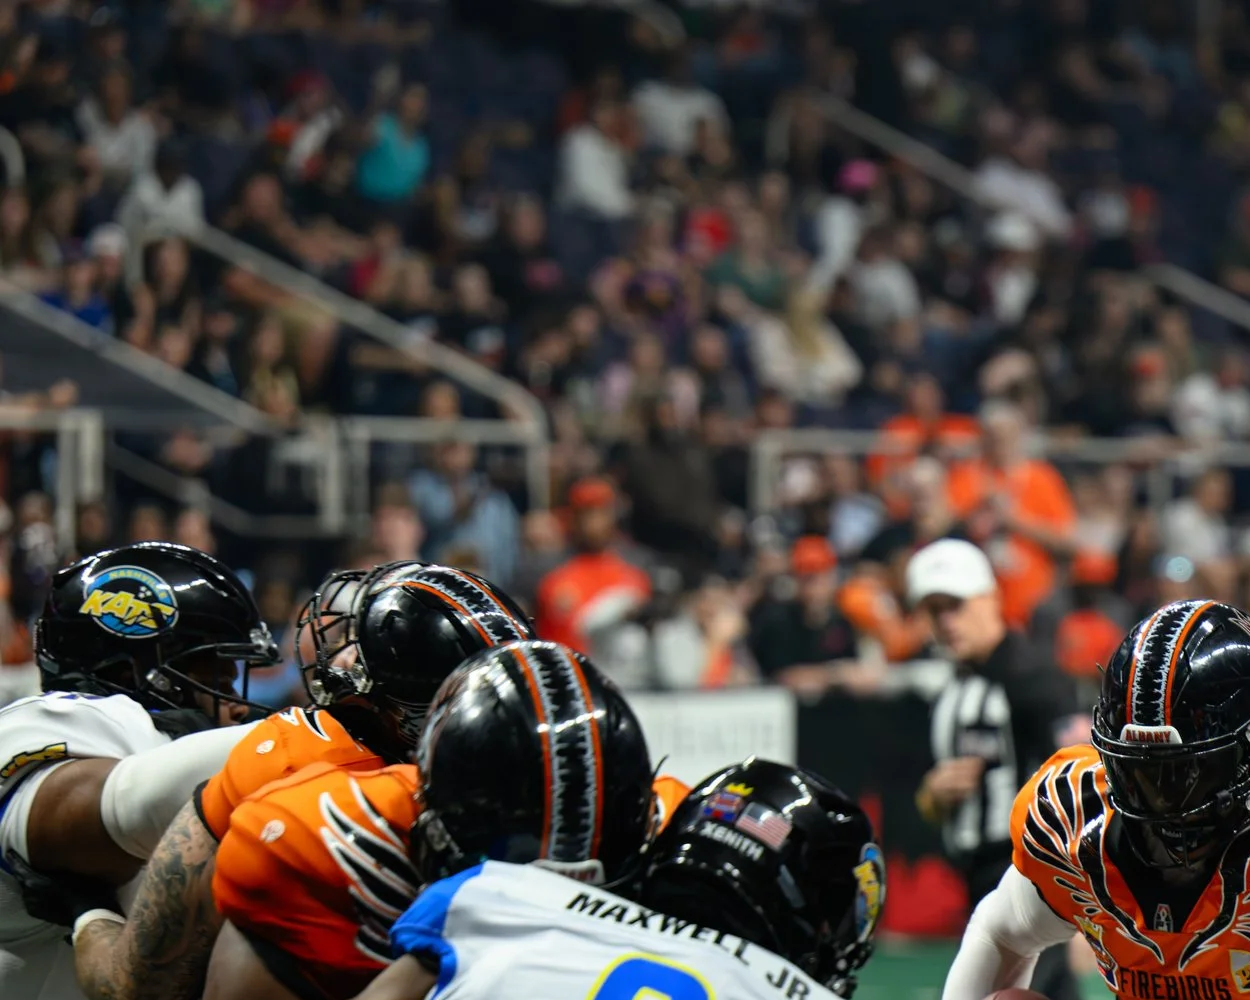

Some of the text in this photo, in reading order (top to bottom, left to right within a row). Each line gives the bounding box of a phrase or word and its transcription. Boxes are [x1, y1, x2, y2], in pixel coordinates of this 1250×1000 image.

[1125, 728, 1171, 744] ALBANY
[699, 820, 765, 862] XENITH
[565, 891, 751, 967] MAXWELL
